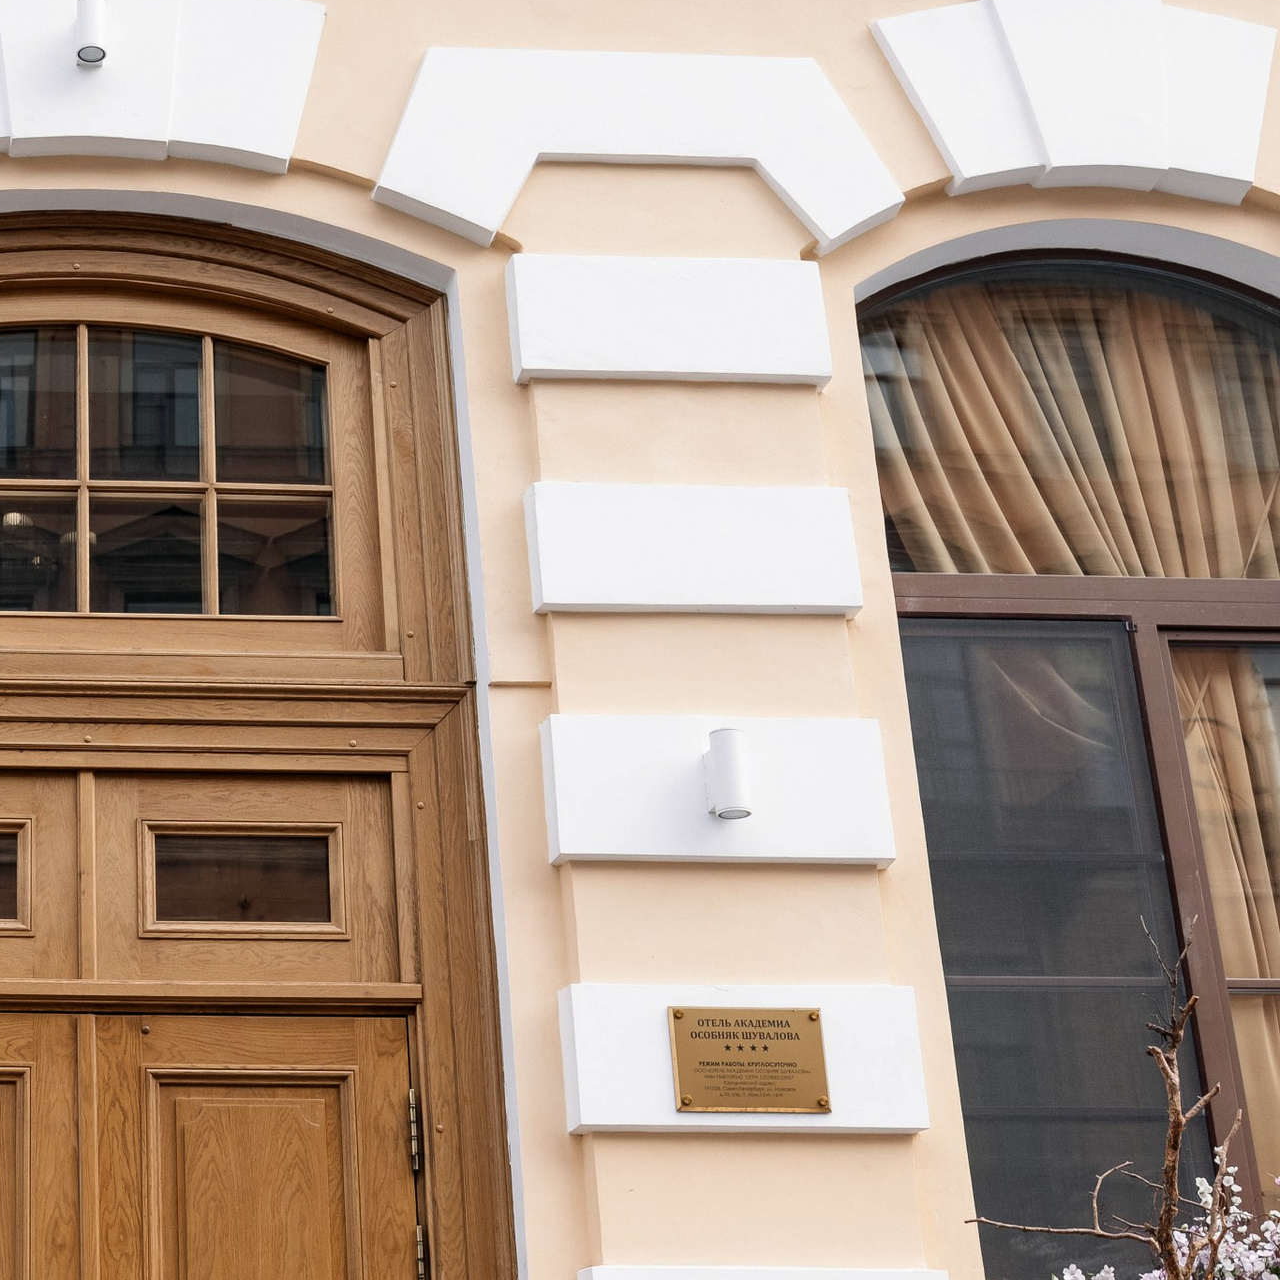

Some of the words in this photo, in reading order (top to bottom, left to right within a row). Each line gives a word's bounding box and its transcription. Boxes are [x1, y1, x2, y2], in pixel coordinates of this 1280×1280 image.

[697, 1018, 732, 1027] ОТЕЛЬ
[734, 1019, 791, 1029] АКАДЕМИА
[690, 1030, 740, 1040] ОСОБНЯК
[741, 1031, 801, 1041] ШУВАЛОВА
